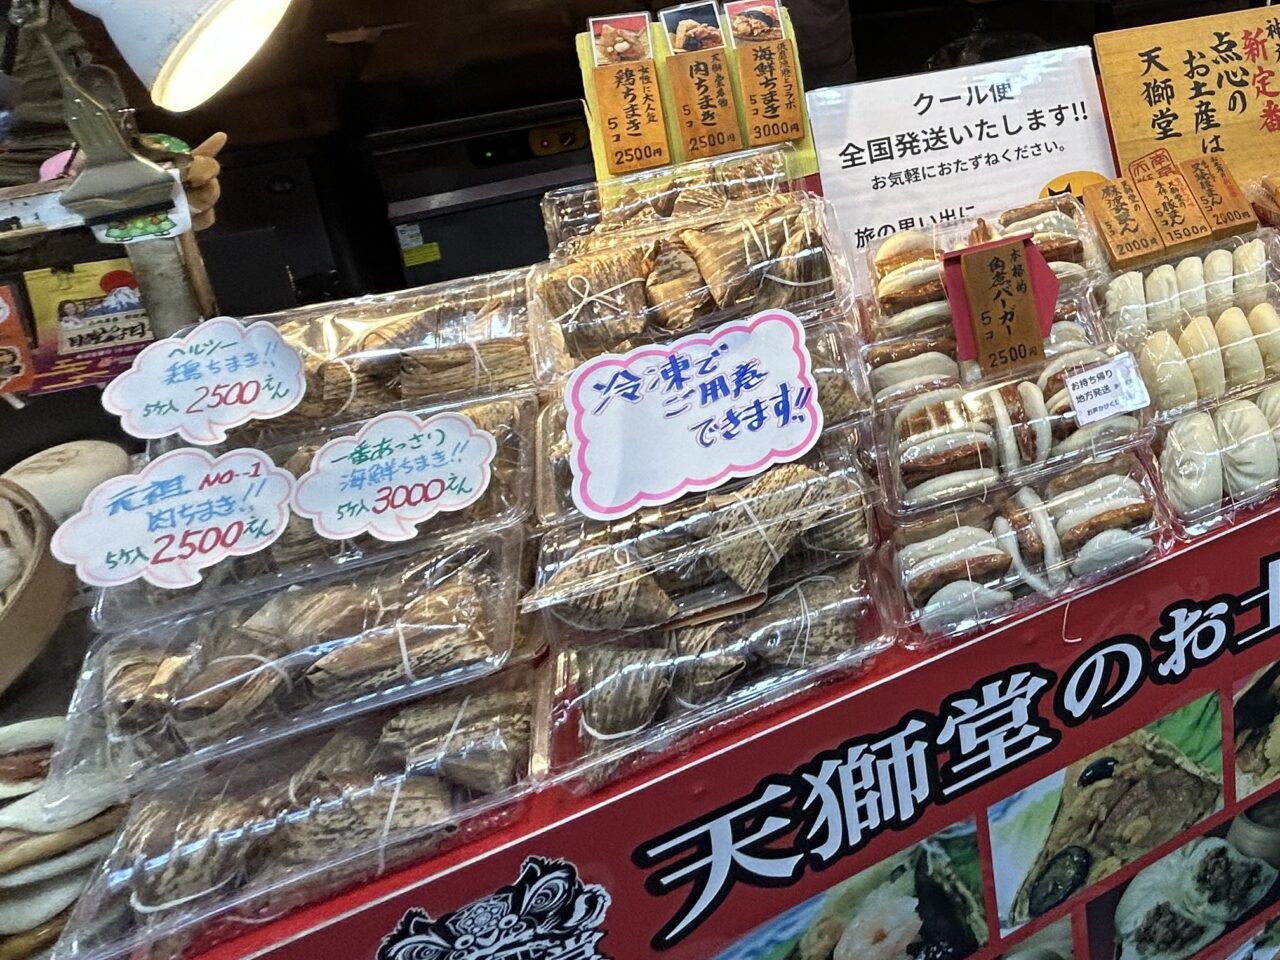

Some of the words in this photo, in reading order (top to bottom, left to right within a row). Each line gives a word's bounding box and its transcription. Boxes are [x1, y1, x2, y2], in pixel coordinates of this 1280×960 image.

[638, 65, 658, 124] 女性に大人気
[689, 61, 717, 128] 肉ちまき
[711, 53, 728, 108] 天獅堂名物
[752, 45, 780, 119] 海鮮ちまき
[913, 81, 1014, 117] クール便
[1138, 46, 1183, 141] 天獅堂
[1209, 31, 1250, 114] 点心の
[614, 68, 643, 138] 鶏ちまき
[1183, 49, 1225, 153] お土産は
[614, 145, 662, 165] 2500円
[689, 132, 736, 152] 2500円
[753, 121, 800, 140] 3000円
[838, 101, 1089, 170] 全国発送いたします!!
[871, 140, 1066, 191] お気軽におたずねください。
[1116, 238, 1158, 256] 2000円
[1167, 225, 1208, 241] 1500円
[989, 256, 1016, 337] 角煮バーガー
[981, 311, 994, 340] 5コ
[592, 342, 731, 416] 冷凍で
[988, 343, 1038, 369] 2500円
[1071, 369, 1112, 391] お持ち帰り
[663, 357, 770, 419] ご用意
[1075, 385, 1112, 403] 地方発送
[692, 384, 813, 448] できます!!
[328, 426, 447, 467] 一番あっさり
[106, 474, 193, 517] 元祖
